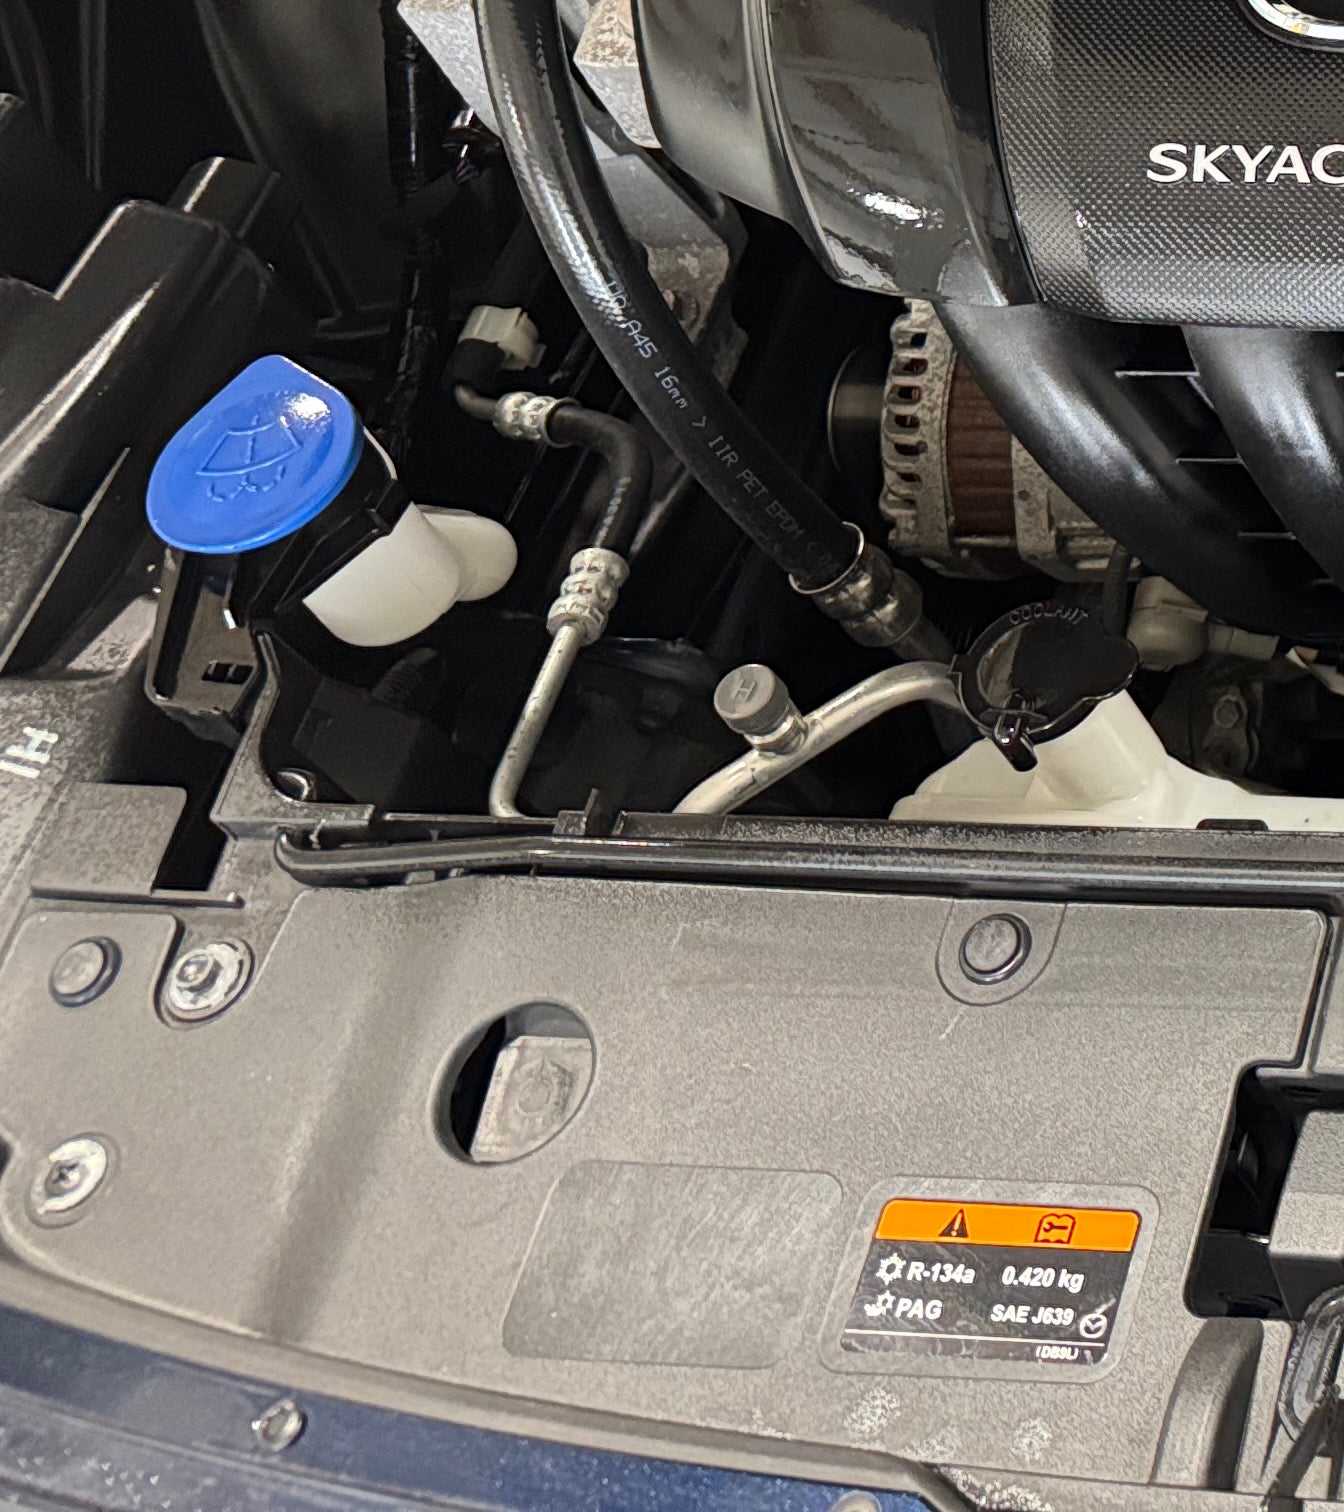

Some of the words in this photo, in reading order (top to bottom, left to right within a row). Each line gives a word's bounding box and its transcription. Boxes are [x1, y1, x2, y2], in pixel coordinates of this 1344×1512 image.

[624, 319, 658, 359] A45
[654, 366, 688, 410] 16mm
[708, 435, 740, 468] IIR
[735, 468, 769, 499] PET
[906, 1261, 976, 1285] R-134a
[1001, 1265, 1055, 1287] 0.420
[1058, 1268, 1085, 1294] kg
[895, 1299, 943, 1320] PAG
[990, 1303, 1031, 1324] SAE
[1031, 1306, 1075, 1326] J639
